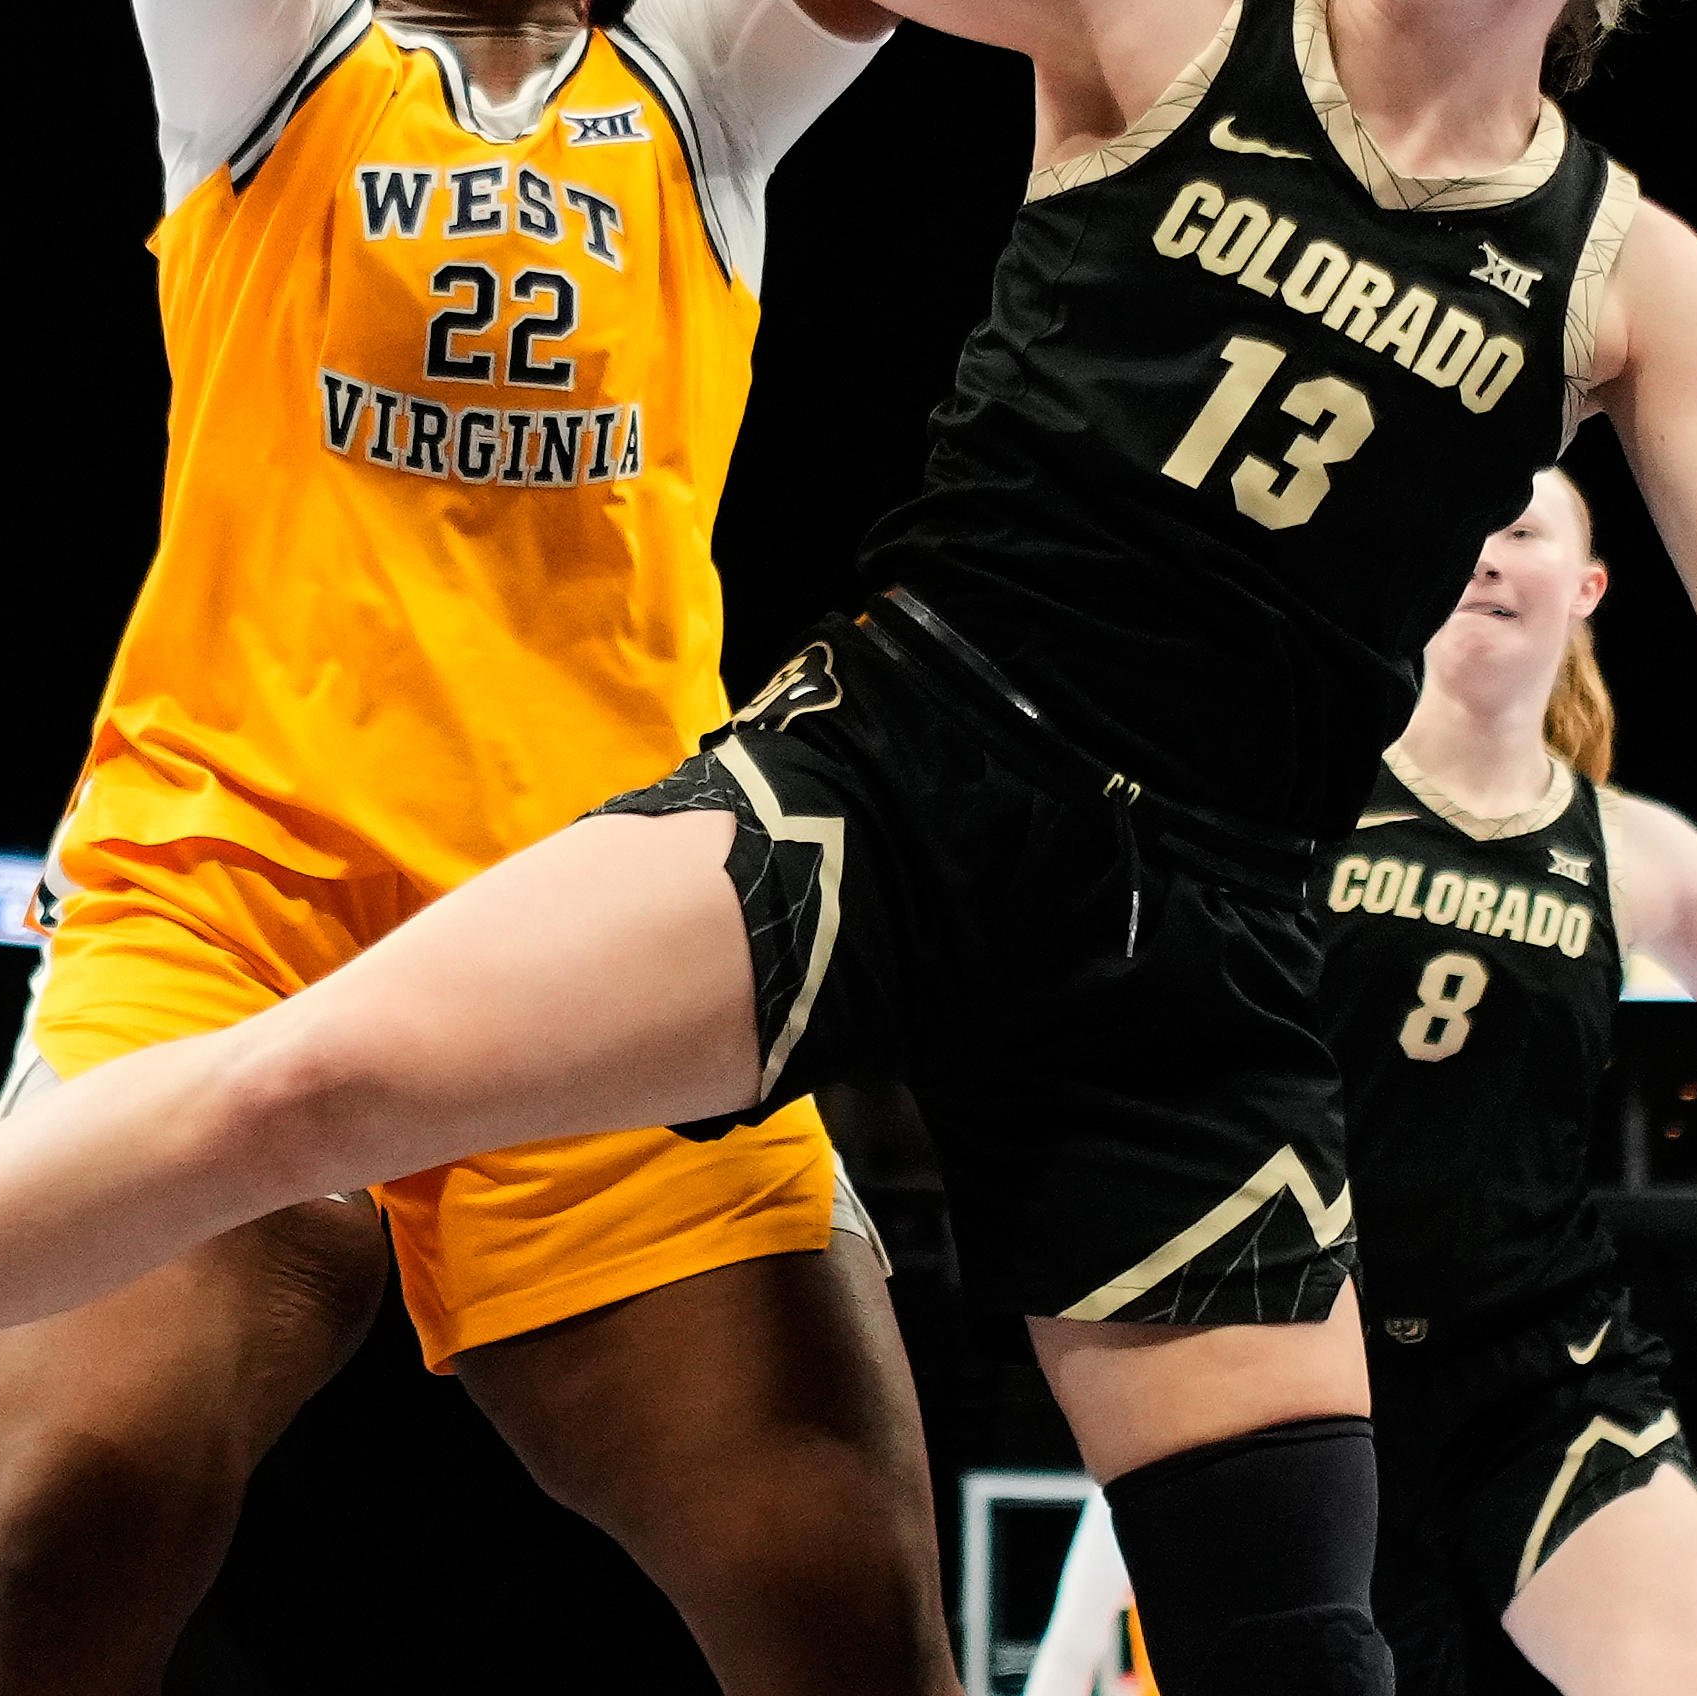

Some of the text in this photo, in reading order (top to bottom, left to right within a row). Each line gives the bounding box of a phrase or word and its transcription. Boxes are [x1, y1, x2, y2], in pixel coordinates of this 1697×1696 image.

[563, 106, 650, 145] XII
[357, 161, 624, 272] WEST
[425, 261, 579, 391] 22
[1151, 180, 1525, 414] COLORADO
[1469, 242, 1543, 308] XII
[320, 368, 644, 488] VIRGINIA
[1160, 335, 1376, 531] 13
[1327, 855, 1593, 959] COLORADO
[1398, 953, 1489, 1062] 8
